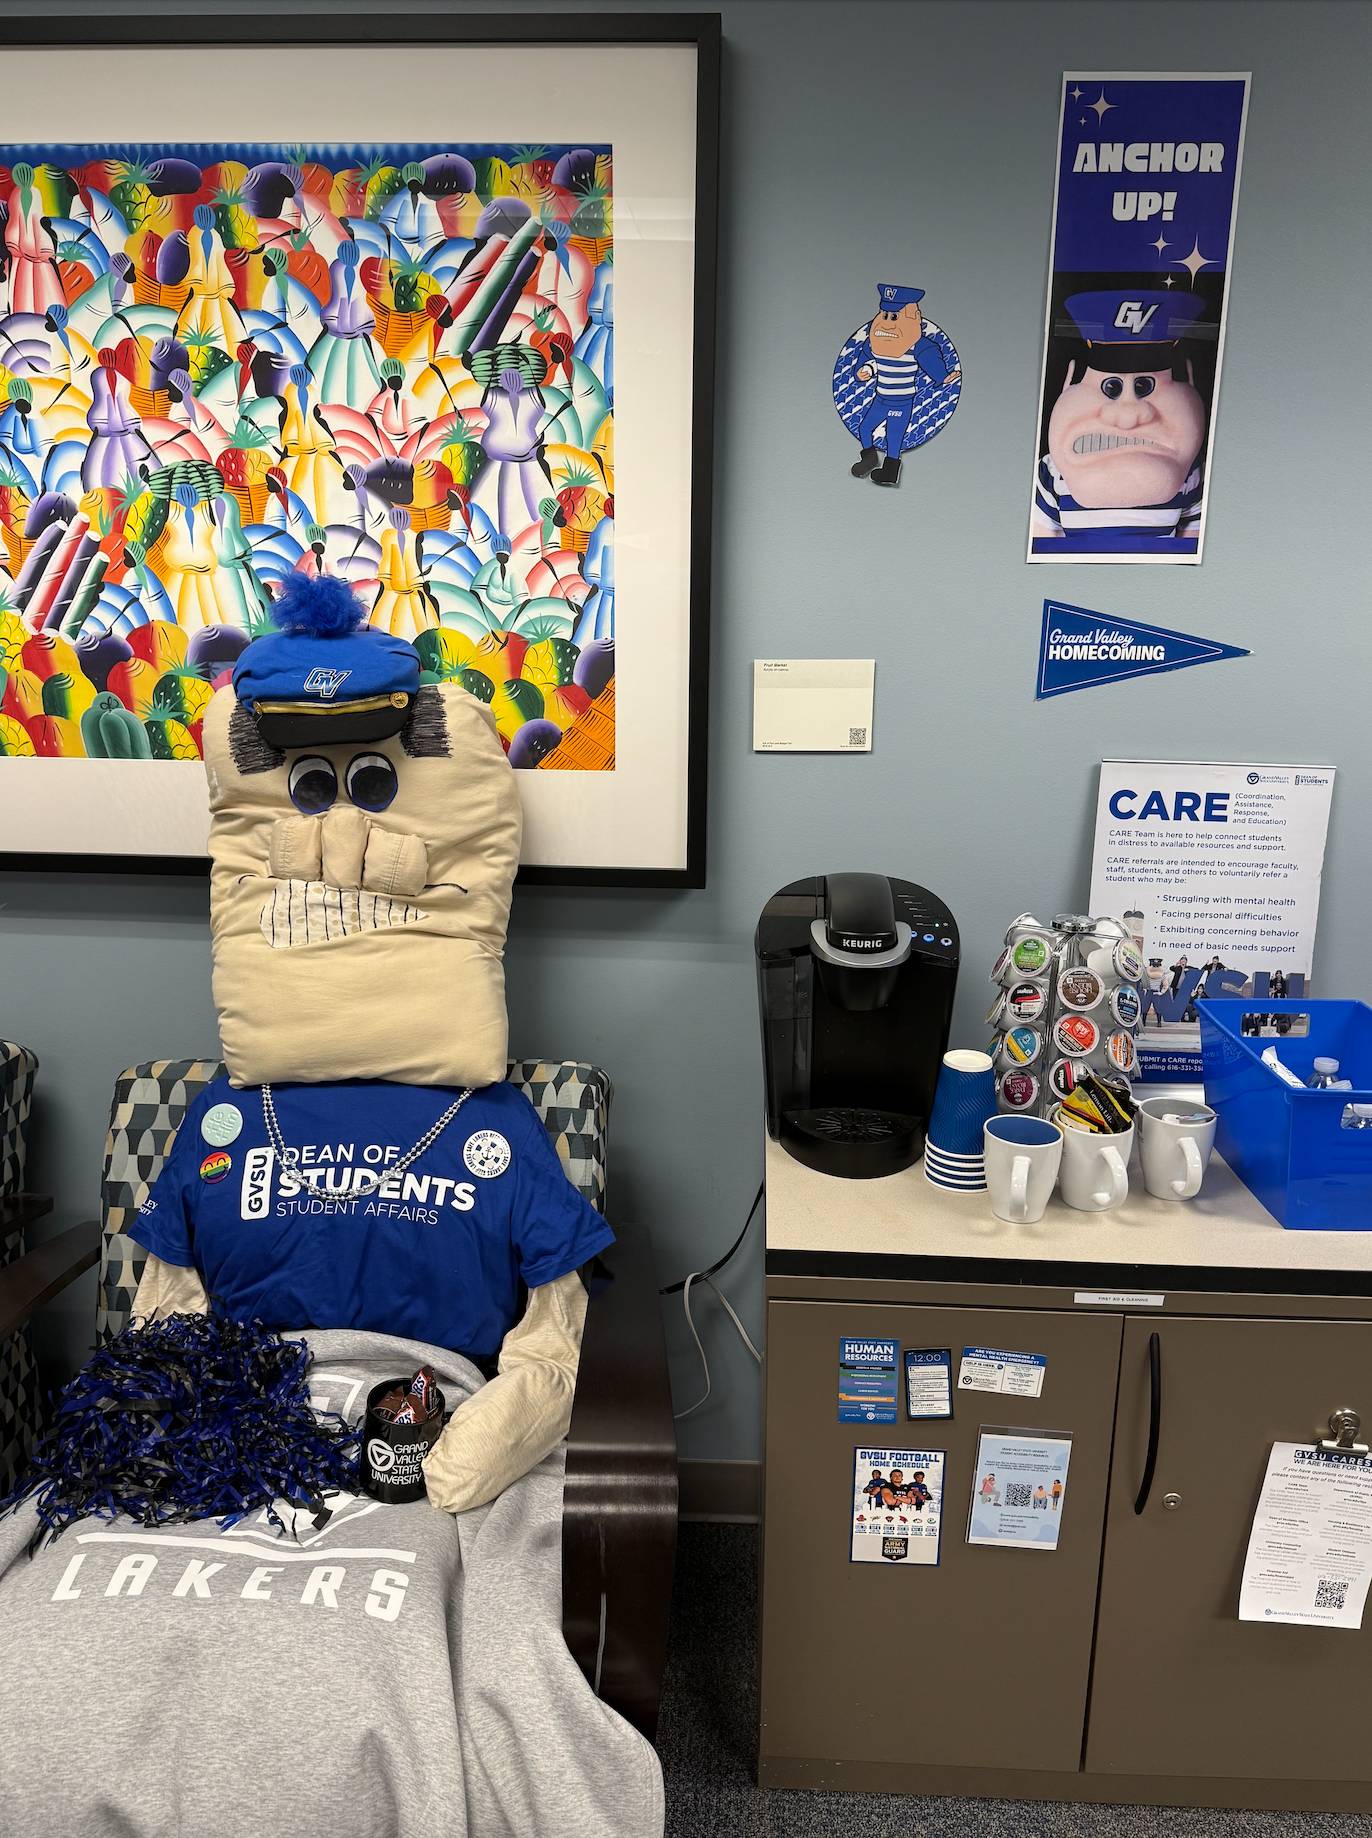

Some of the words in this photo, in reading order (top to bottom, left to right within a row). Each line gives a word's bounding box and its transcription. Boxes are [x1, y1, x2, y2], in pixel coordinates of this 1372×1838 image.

[1072, 142, 1225, 173] ANCHOR
[1112, 191, 1178, 221] UP!
[1113, 301, 1160, 333] GV
[1050, 628, 1092, 644] Grand
[1094, 628, 1135, 648] Valley
[1048, 645, 1165, 661] HOMECOMING
[1109, 790, 1230, 822] CARE
[1109, 829, 1133, 838] CARE
[1133, 830, 1156, 838] Team
[1157, 831, 1164, 839] is
[1165, 831, 1184, 839] here
[1195, 832, 1213, 841] help
[1214, 833, 1247, 841] connect
[1247, 834, 1283, 843] students
[1108, 838, 1116, 846] in
[1117, 838, 1149, 848] distress
[1235, 843, 1253, 851] and
[1253, 844, 1286, 852] support.
[1106, 856, 1131, 865] CARE
[1180, 858, 1216, 867] intended
[1270, 861, 1299, 871] faculty,
[1105, 865, 1126, 874] staff,
[1165, 867, 1181, 875] and
[1181, 867, 1207, 876] others
[1208, 869, 1218, 877] to
[1262, 870, 1282, 879] refer
[1105, 875, 1135, 883] student
[1137, 875, 1155, 883] who
[1155, 877, 1173, 885] may
[1174, 876, 1187, 885] be:
[1162, 894, 1210, 905] Struggling
[1212, 895, 1232, 904] with
[1233, 897, 1266, 905] mental
[1267, 897, 1296, 907] health
[1161, 909, 1191, 920] Facing
[1193, 911, 1233, 920] personal
[1234, 911, 1283, 922] difficulties
[1159, 925, 1205, 936] Exhibiting
[1207, 927, 1258, 937] concerning
[1259, 928, 1300, 938] behavior
[842, 938, 882, 948] KEURIG
[1158, 940, 1167, 949] In
[1169, 941, 1192, 949] need
[1193, 941, 1204, 950] of
[1205, 941, 1231, 951] basic
[1231, 943, 1259, 952] needs
[1260, 945, 1296, 954] support
[1137, 1055, 1160, 1063] SUBMIT
[1144, 1063, 1166, 1071] calling
[1089, 1089, 1103, 1111] Lemon
[282, 1143, 355, 1165] DEAN
[363, 1144, 401, 1165] OF
[247, 1154, 269, 1213] GVSU
[276, 1167, 477, 1212] STUDENTS
[276, 1199, 360, 1217] STUDENT
[364, 1201, 440, 1225] AFFAIRS
[845, 1344, 894, 1354] HUMAN
[845, 1354, 893, 1362] RESOURCES
[914, 1354, 941, 1362] 12:00
[393, 1441, 429, 1453] GRAND
[394, 1452, 428, 1465] VALLEY
[860, 1451, 887, 1460] GVSU
[889, 1452, 940, 1462] FOOTBALL
[1295, 1451, 1327, 1460] GVSU
[1331, 1455, 1372, 1467] CARES
[392, 1465, 420, 1475] STATE
[892, 1461, 930, 1469] SCHEDULE
[371, 1469, 422, 1485] UNIVERSITY
[51, 1553, 409, 1622] LAKERS
